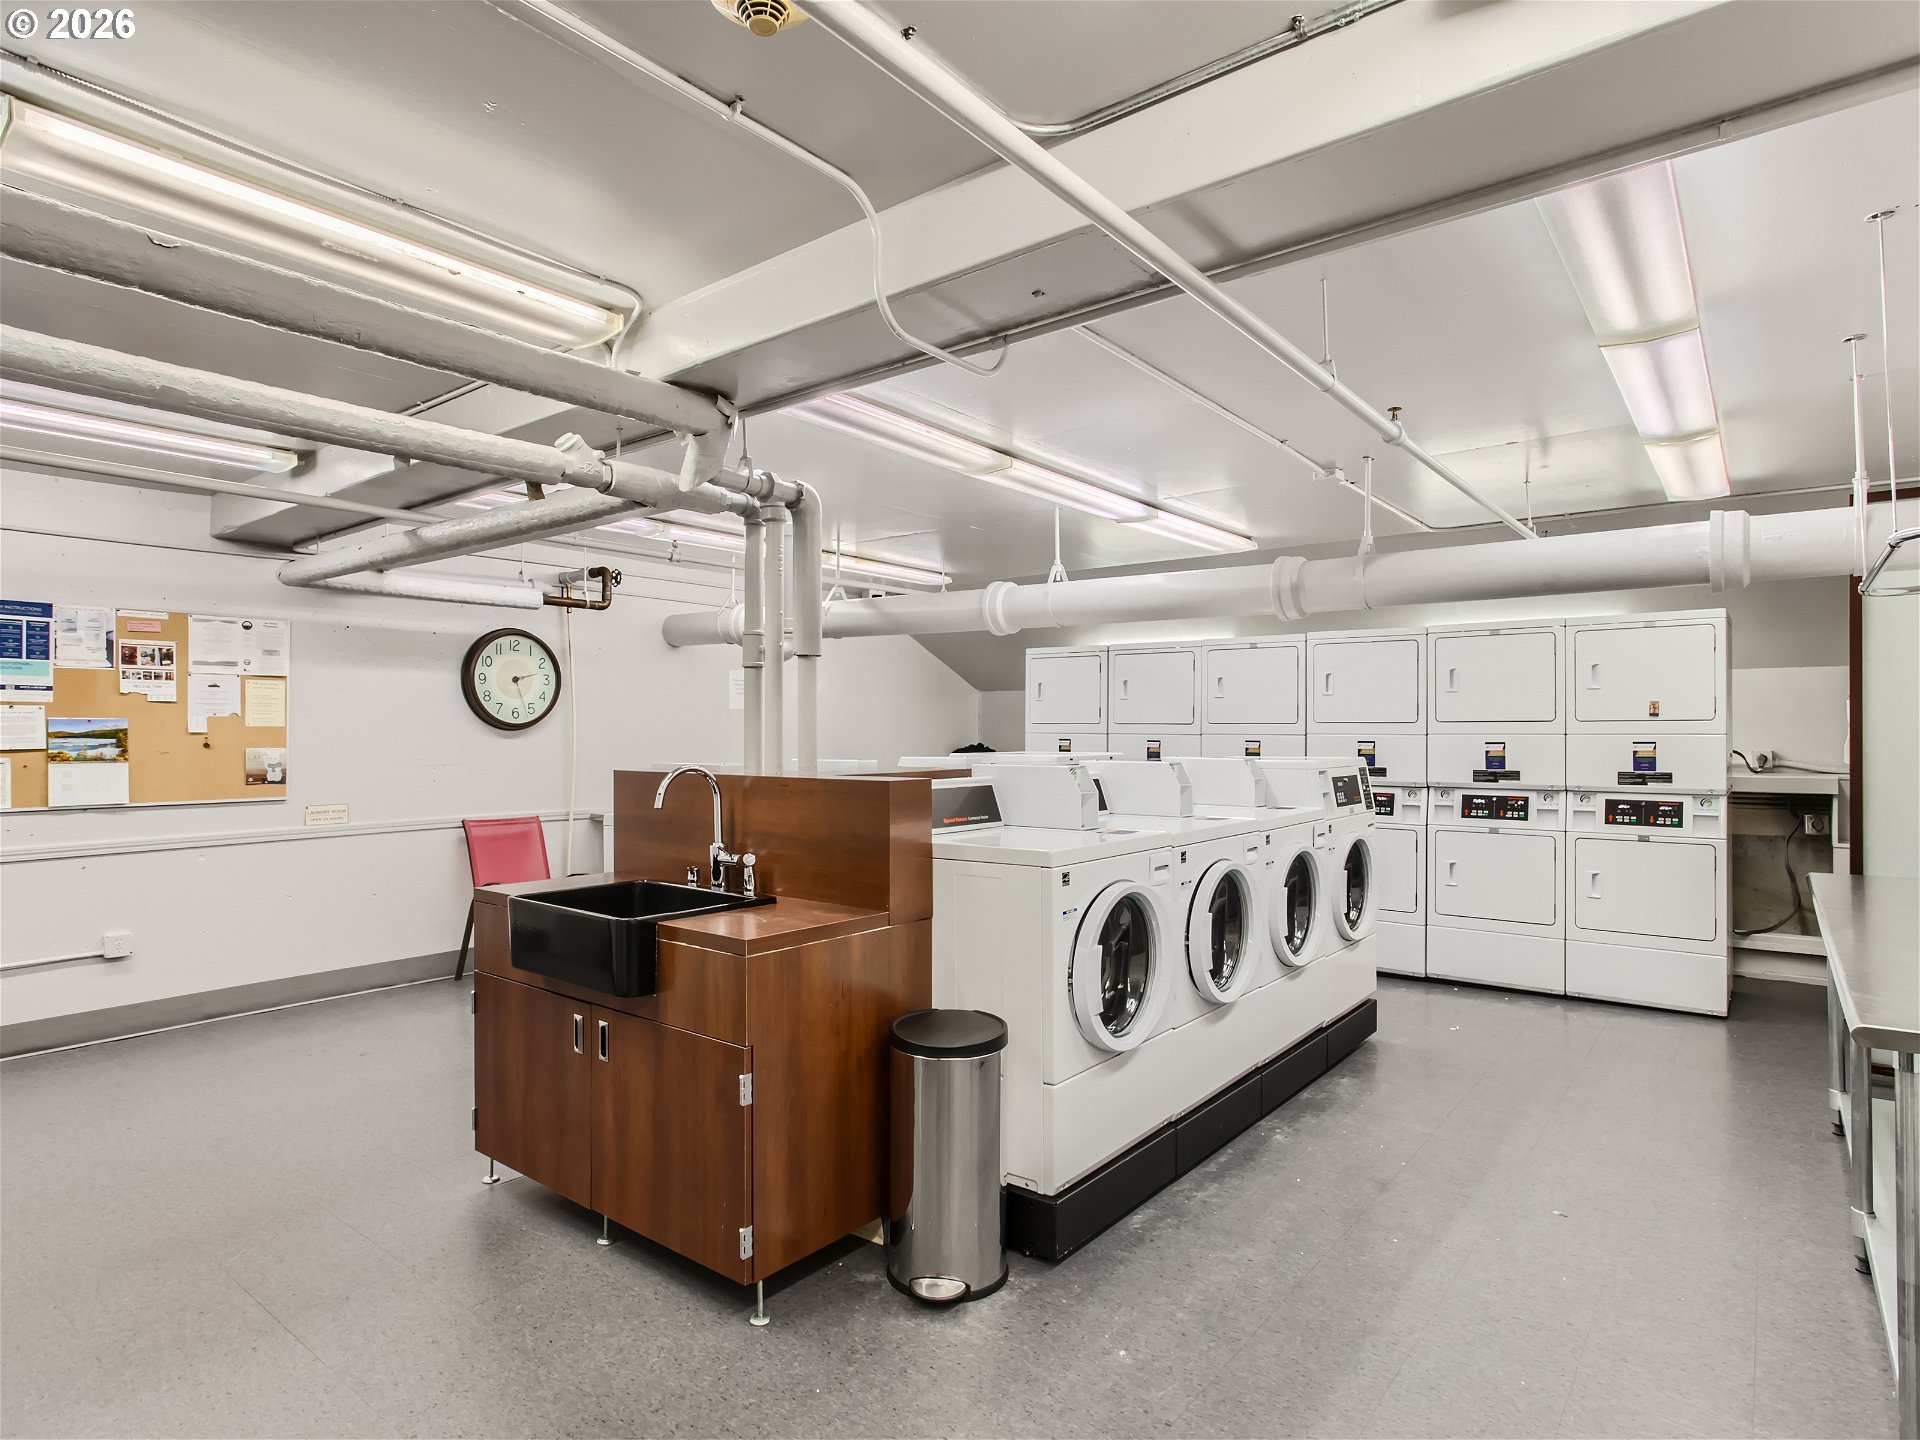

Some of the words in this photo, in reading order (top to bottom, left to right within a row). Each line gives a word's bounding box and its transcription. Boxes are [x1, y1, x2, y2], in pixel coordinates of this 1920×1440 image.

[495, 643, 502, 655] 11
[509, 639, 520, 652] 12
[481, 655, 493, 667] 10
[538, 657, 546, 670] 2
[478, 672, 487, 685] 9
[543, 674, 550, 686] 3
[482, 690, 491, 702] 8
[538, 691, 546, 702] 4
[495, 702, 503, 714] 7
[511, 707, 520, 720] 6
[527, 702, 536, 715] 5
